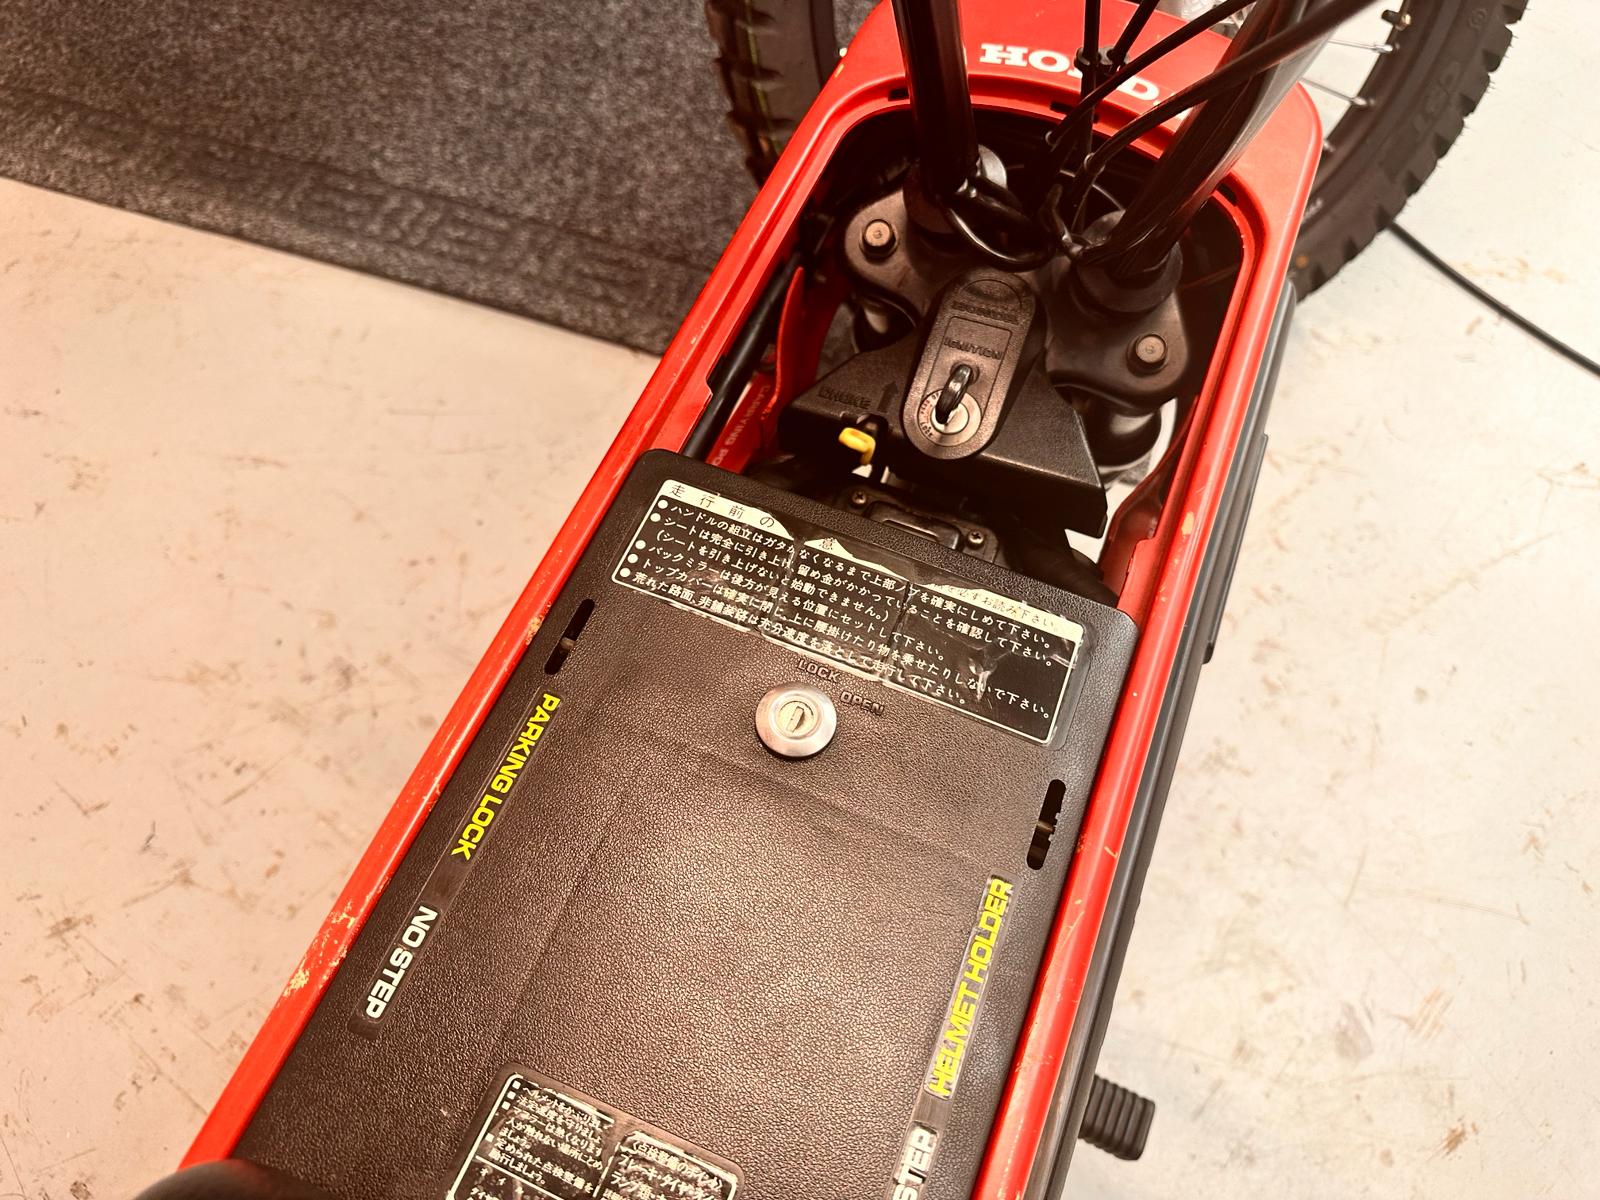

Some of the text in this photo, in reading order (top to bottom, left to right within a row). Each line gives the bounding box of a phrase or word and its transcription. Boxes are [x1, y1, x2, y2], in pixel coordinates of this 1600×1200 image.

[943, 337, 1004, 361] IGNITION
[797, 658, 840, 683] LOCK
[840, 690, 885, 716] OPEN
[450, 692, 561, 861] PARKING LOCK
[365, 905, 439, 1019] NO STEP
[929, 877, 1013, 1098] HELMET HOLDER
